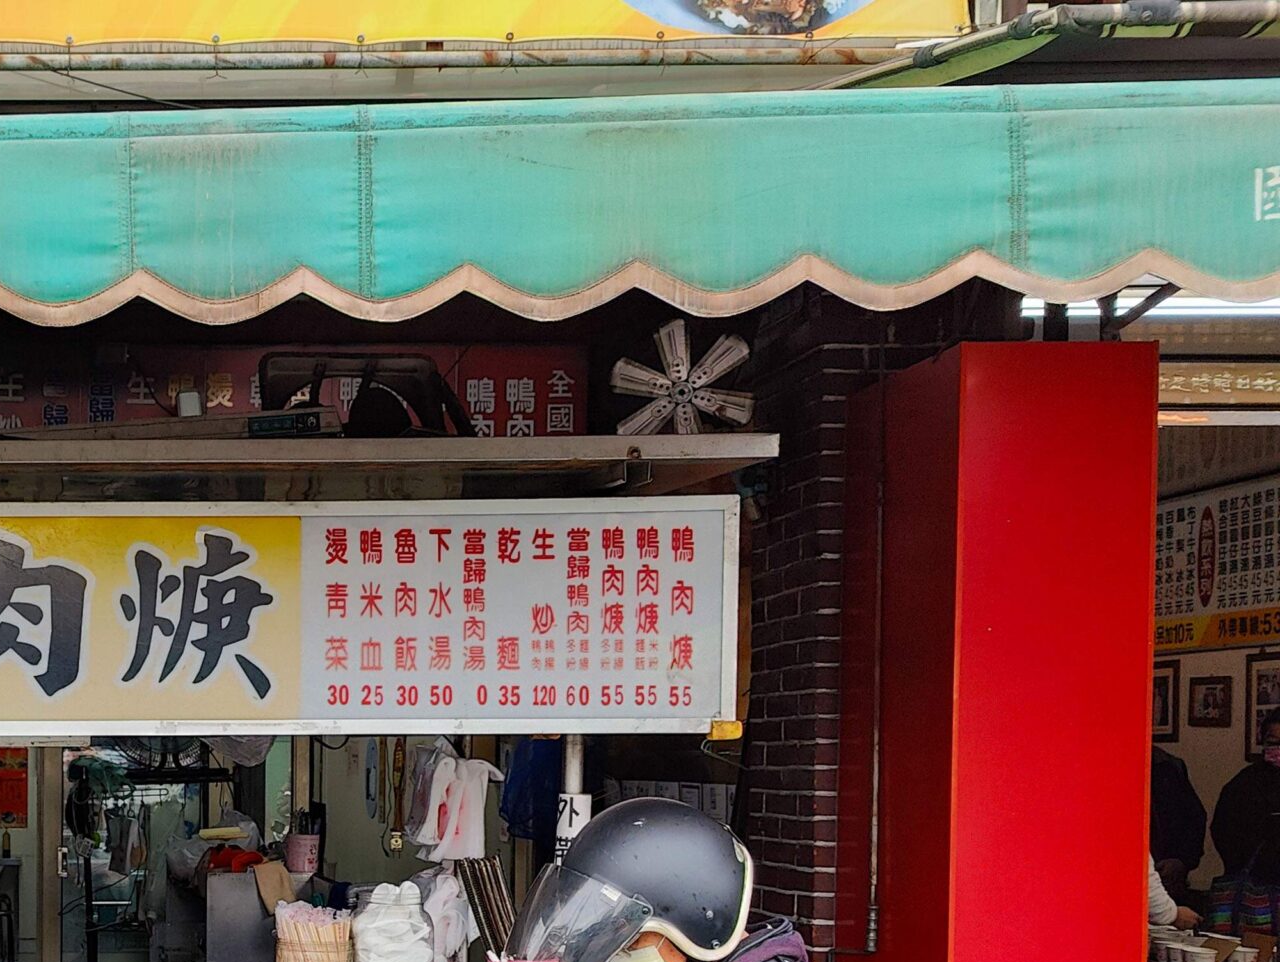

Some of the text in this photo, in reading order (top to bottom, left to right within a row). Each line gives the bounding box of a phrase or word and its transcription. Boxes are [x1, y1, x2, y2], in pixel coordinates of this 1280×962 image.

[546, 368, 576, 433] 全國
[358, 527, 384, 672] 鴨米血
[393, 527, 419, 672] 魯肉飯
[428, 527, 453, 671] 下水湯
[462, 528, 488, 671] 當歸鴨肉湯
[327, 683, 351, 707] 30
[360, 684, 385, 707] 25
[396, 684, 420, 707] 30
[430, 684, 454, 707] 50
[498, 684, 522, 707] 35
[531, 684, 558, 707] 120
[565, 684, 591, 707] 60
[600, 684, 625, 707] 55
[634, 684, 658, 706] 55
[668, 685, 693, 707] 55
